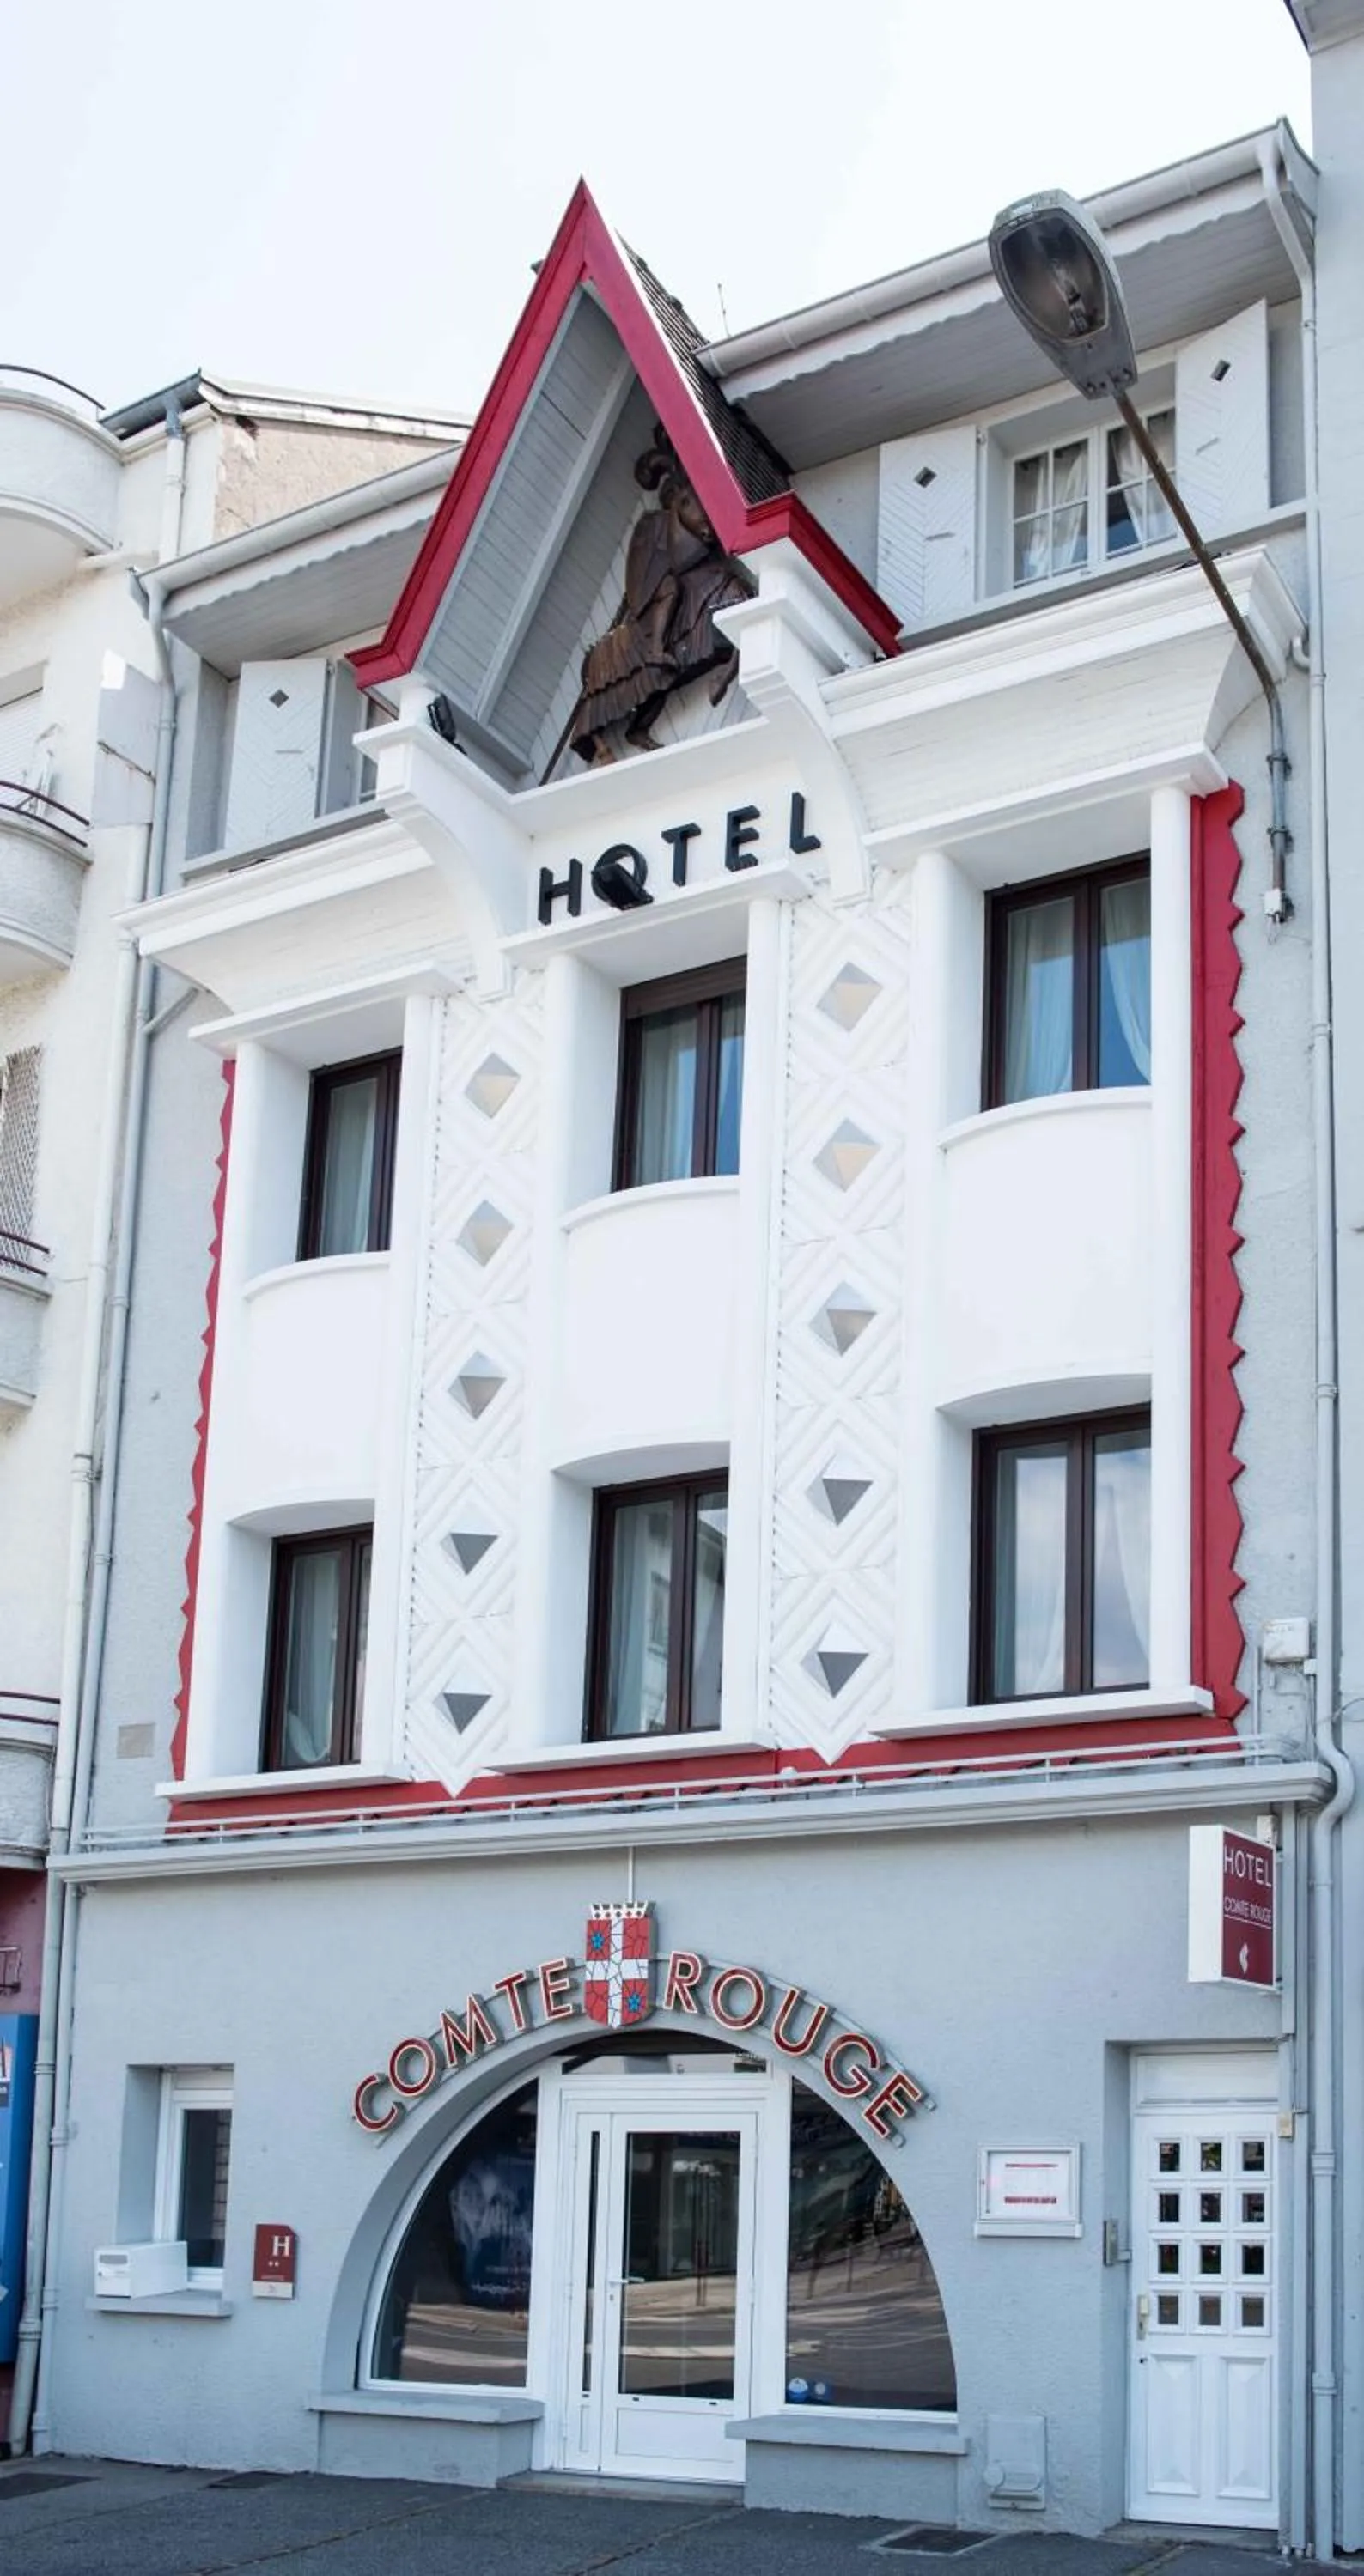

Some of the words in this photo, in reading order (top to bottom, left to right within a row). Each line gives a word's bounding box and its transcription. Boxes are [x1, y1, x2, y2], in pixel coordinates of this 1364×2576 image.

[538, 791, 822, 926] HOTEL
[1224, 1844, 1272, 1887] HOTEL
[1250, 1901, 1272, 1924] ROUGE
[353, 1956, 577, 2133] COMTE
[663, 1950, 923, 2139] ROUGE
[272, 2235, 290, 2257] H
